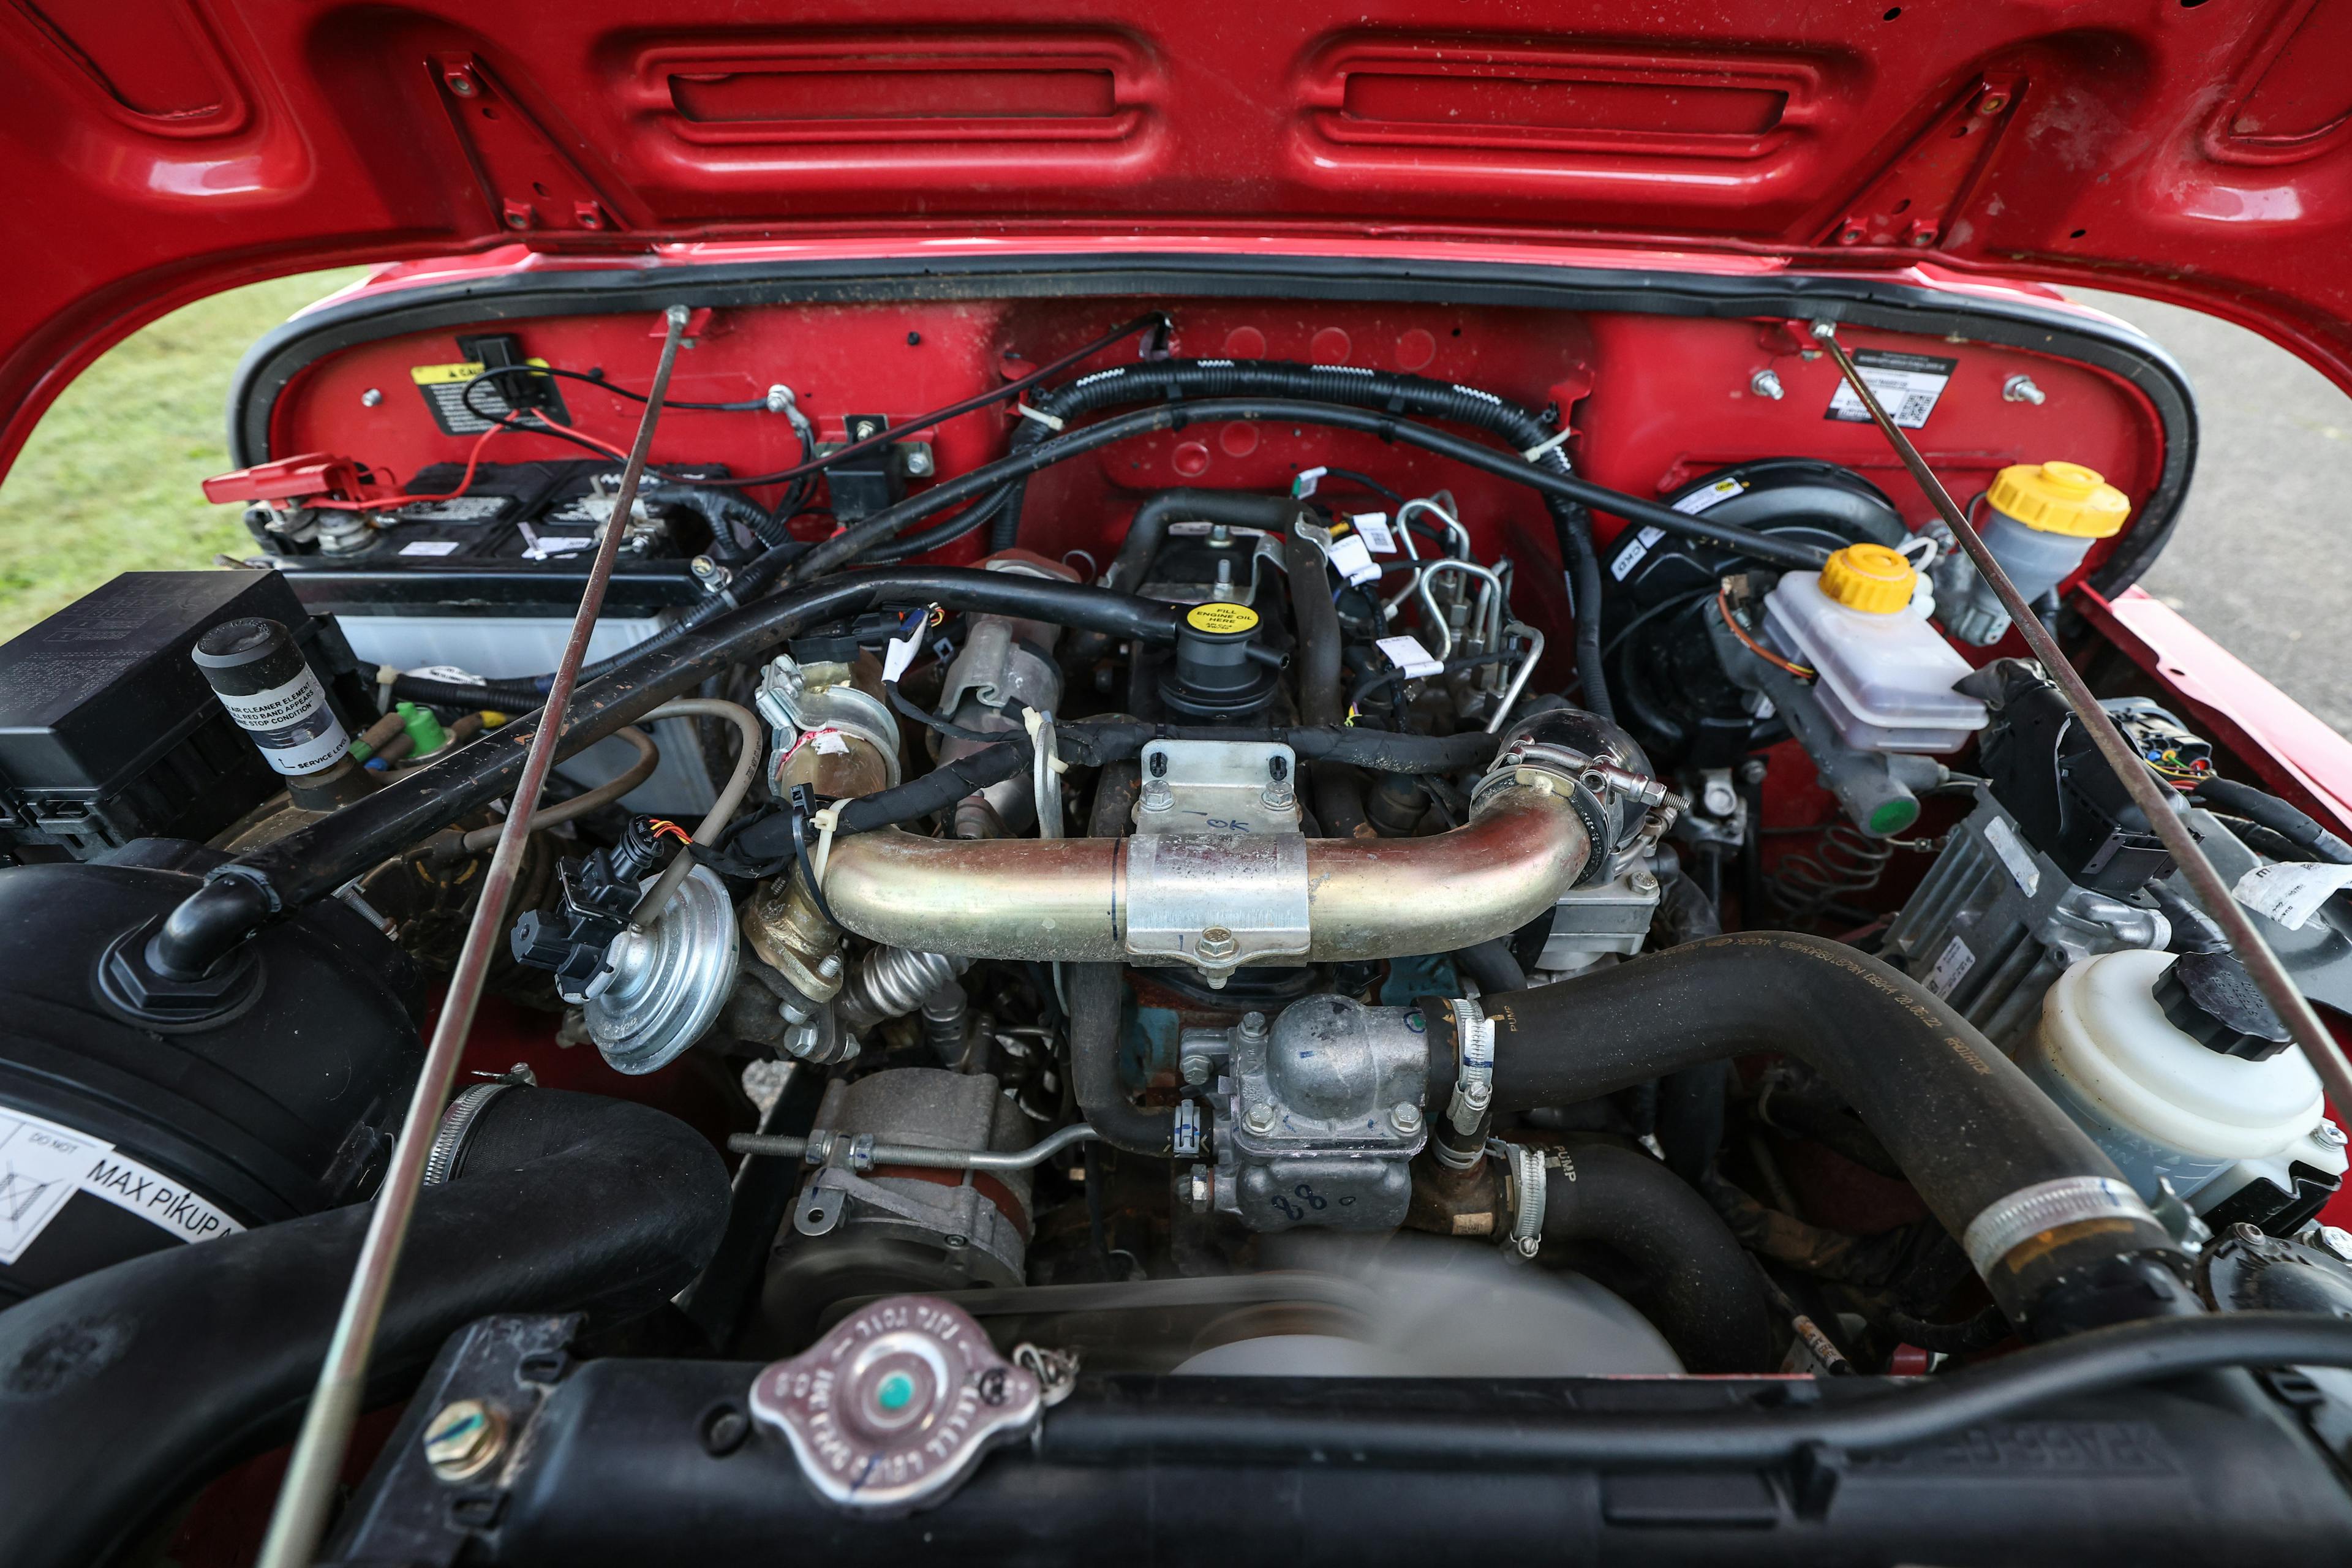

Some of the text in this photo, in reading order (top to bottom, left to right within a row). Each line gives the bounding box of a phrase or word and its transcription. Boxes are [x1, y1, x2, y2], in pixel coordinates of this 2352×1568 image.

[243, 701, 281, 714] CLEANER
[282, 682, 311, 704] ELEMENT
[260, 708, 284, 719] BAND
[285, 690, 314, 712] APPEARS
[298, 752, 333, 770] SERVICE
[1504, 1005, 1518, 1031] PUMP
[1553, 1145, 1577, 1182] PUMP
[86, 1159, 153, 1202] MAX
[148, 1188, 219, 1235] PIKUP
